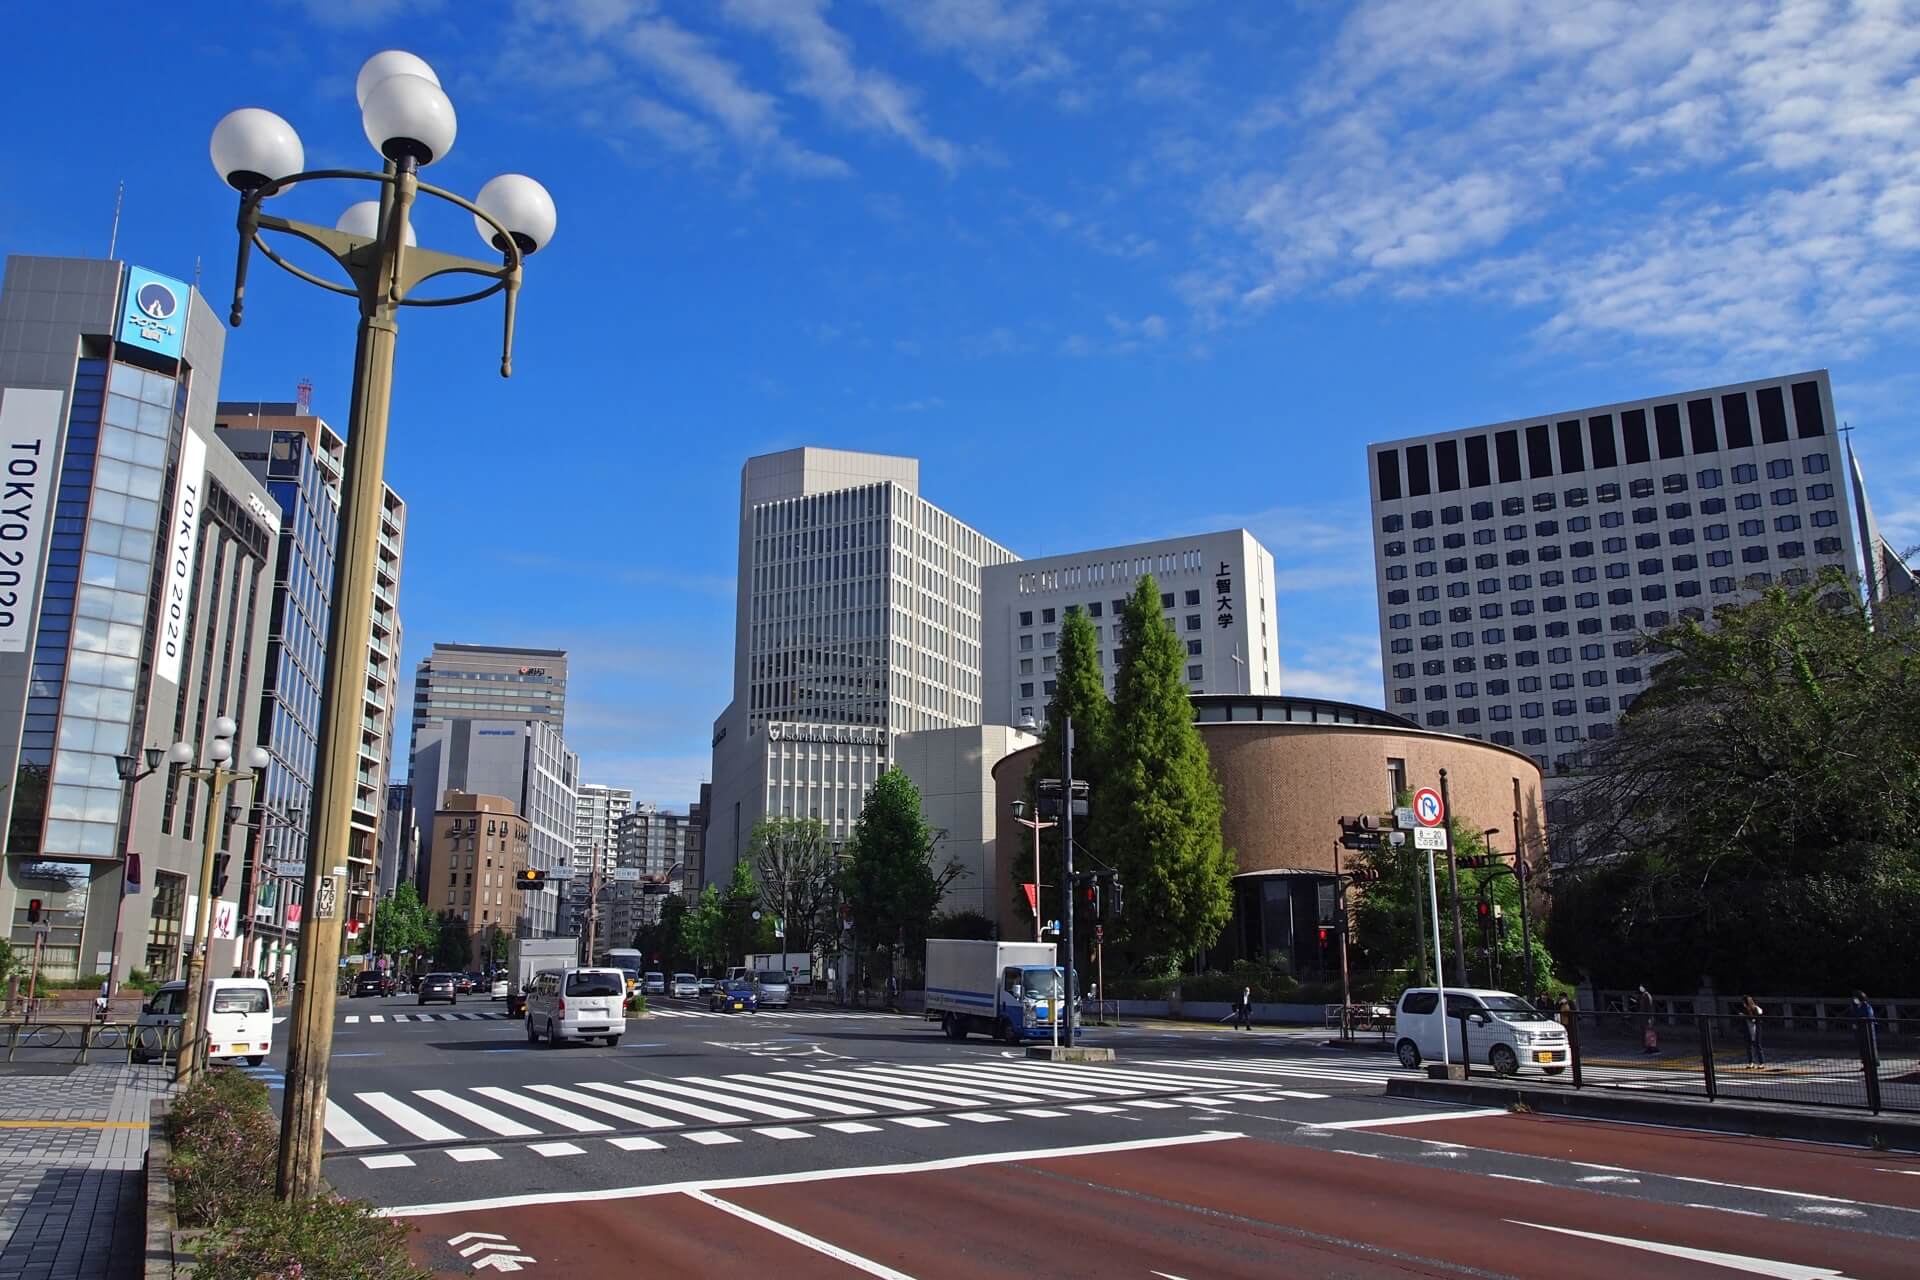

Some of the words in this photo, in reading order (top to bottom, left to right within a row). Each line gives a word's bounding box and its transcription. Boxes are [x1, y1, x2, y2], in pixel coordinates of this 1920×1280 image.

[0, 440, 41, 540] TOKYO
[176, 484, 197, 578] TOKYO
[166, 584, 183, 658] 2020
[1215, 561, 1234, 628] 上智大学
[785, 732, 824, 743] SOPHIA
[825, 735, 885, 745] UNIVERSITY
